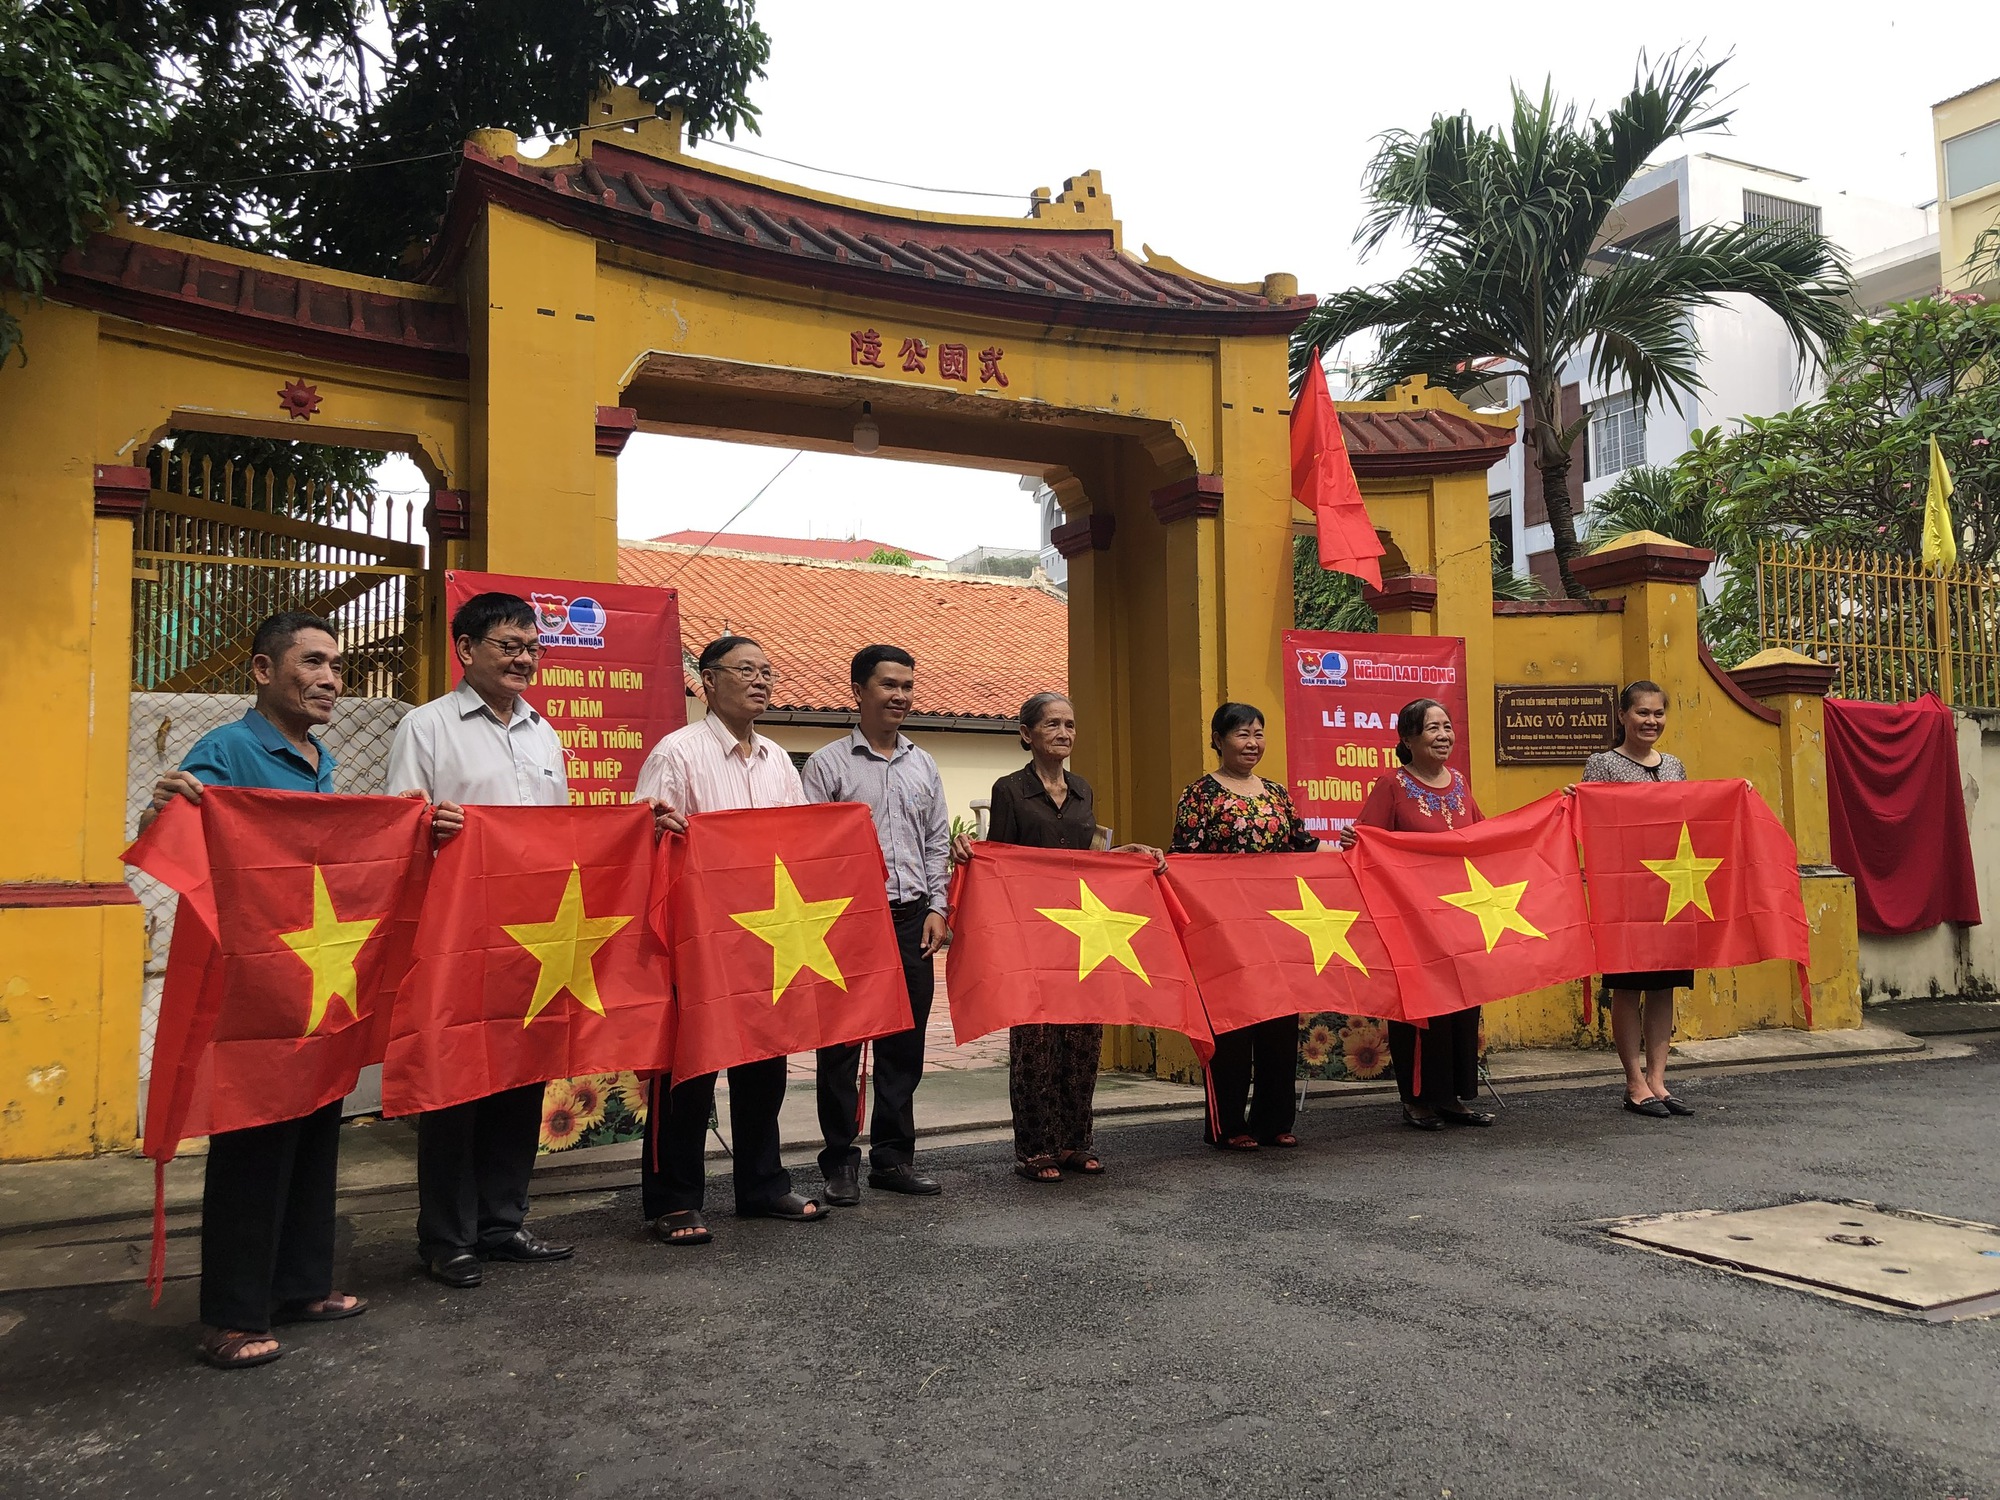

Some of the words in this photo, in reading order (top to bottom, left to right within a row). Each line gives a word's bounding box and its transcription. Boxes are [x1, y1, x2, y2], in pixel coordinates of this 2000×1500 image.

[540, 634, 559, 646] QUẬN
[562, 634, 576, 645] PHÚ
[578, 637, 602, 648] NHUẬN
[542, 665, 584, 687] MỪNG
[588, 666, 605, 688] KỶ
[610, 668, 642, 692] NIỆM
[1355, 664, 1392, 680] NGƯỜI
[1395, 666, 1419, 681] LAO
[1421, 666, 1454, 684] ĐỘNG
[546, 699, 566, 717] 67
[570, 696, 602, 718] NĂM
[1322, 705, 1346, 728] LỄ
[1354, 712, 1383, 729] RA
[1506, 712, 1543, 728] LĂNG
[1547, 712, 1564, 727] VÕ
[1570, 711, 1608, 726] TÁNH
[602, 724, 642, 749] THỐNG
[1336, 743, 1378, 768] CÔNG
[594, 758, 622, 782] HIỆP
[1304, 816, 1328, 831] ĐOÀN
